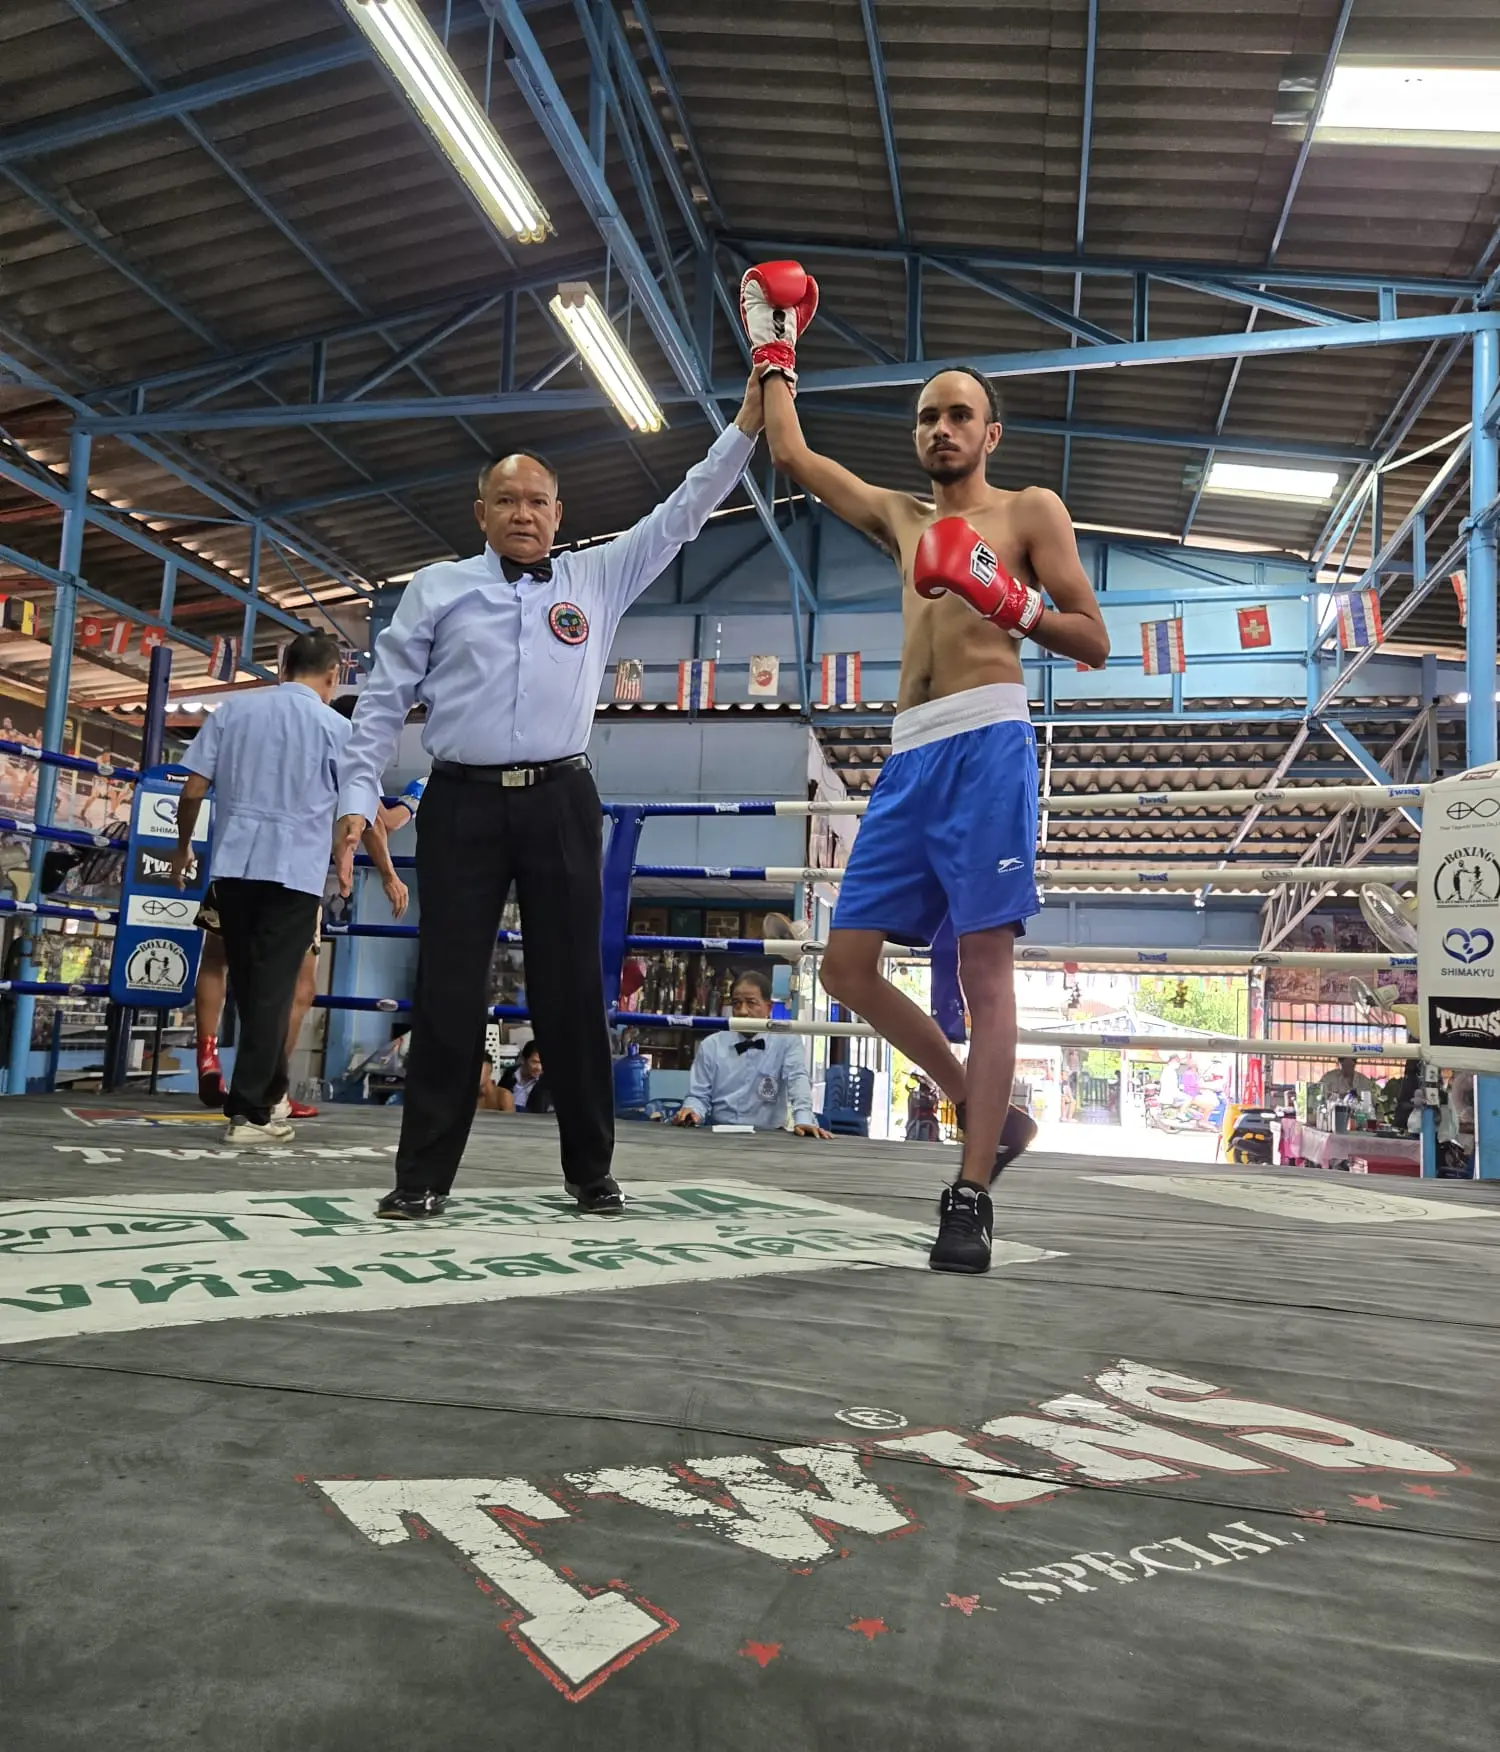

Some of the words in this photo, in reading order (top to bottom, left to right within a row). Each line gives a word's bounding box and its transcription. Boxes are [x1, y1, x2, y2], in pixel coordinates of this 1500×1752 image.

[1443, 846, 1496, 865] BOXING
[139, 940, 181, 956] BOXING
[1440, 967, 1495, 978] SHIMAKYU
[1436, 1006, 1500, 1037] TWINS
[52, 1144, 400, 1164] TWIN
[312, 1358, 1460, 1690] TWINS
[998, 1520, 1306, 1605] SPECIAL
